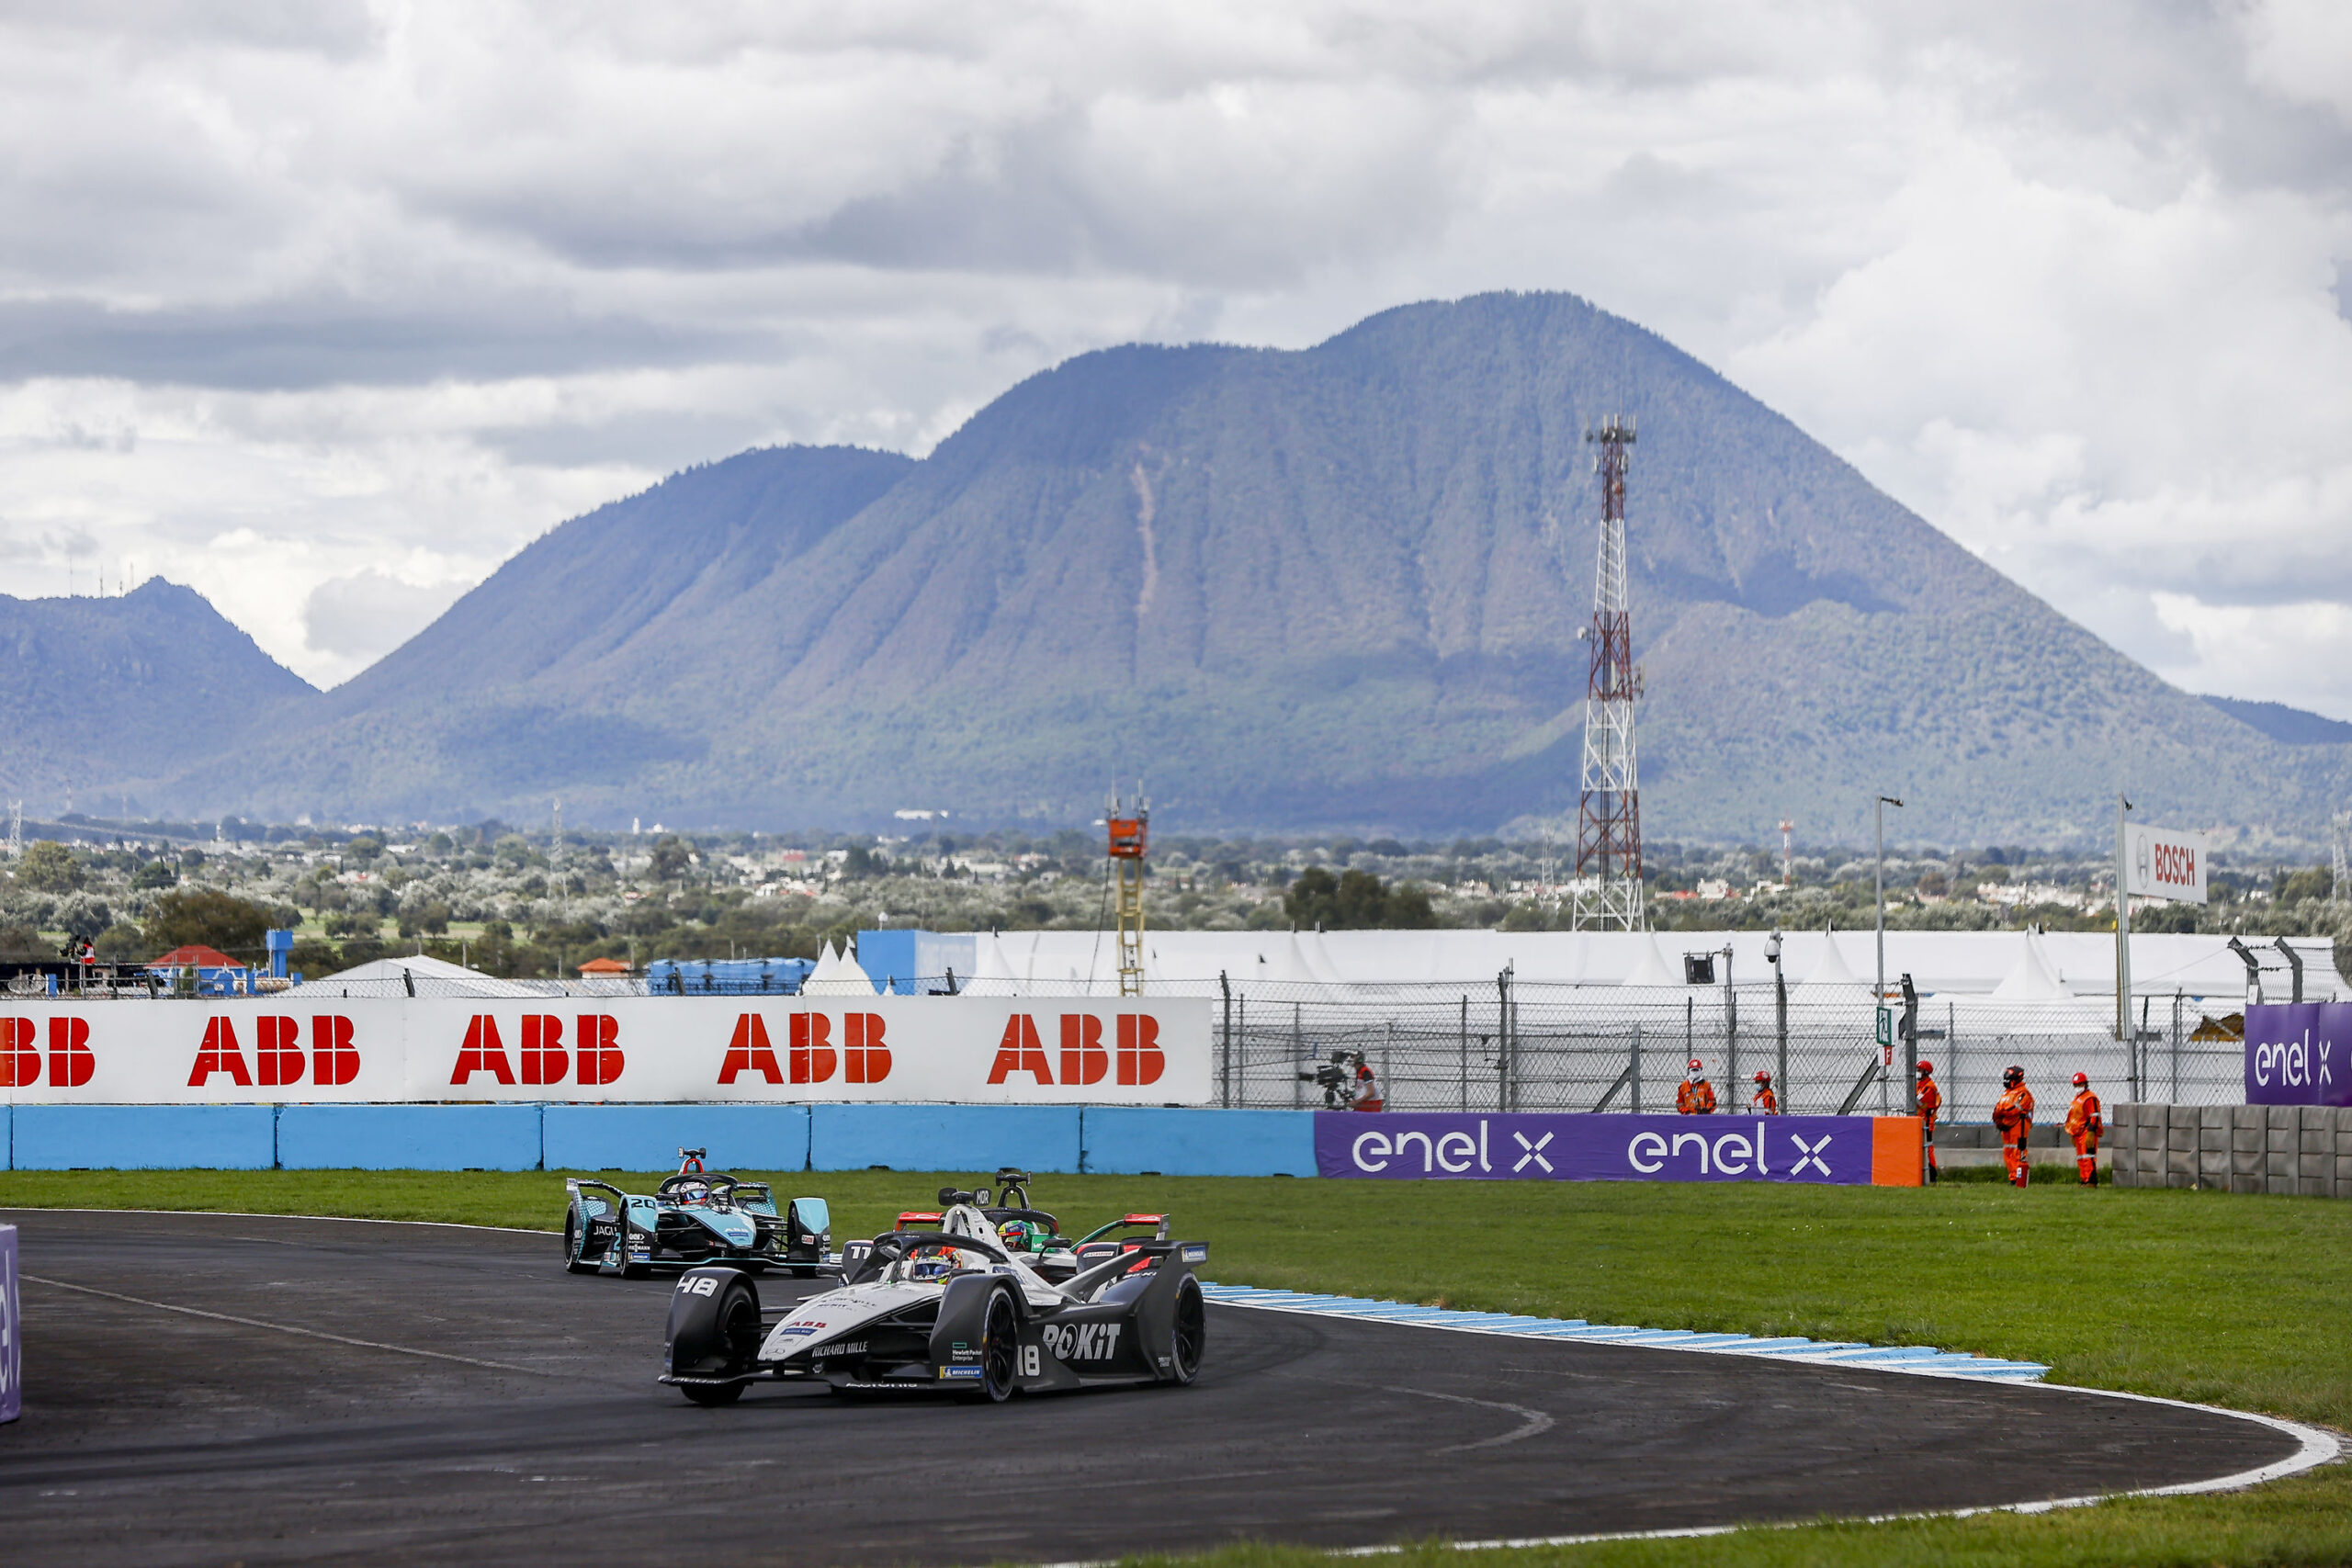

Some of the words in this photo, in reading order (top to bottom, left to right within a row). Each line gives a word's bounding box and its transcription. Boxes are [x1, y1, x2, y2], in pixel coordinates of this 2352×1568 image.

[2155, 842, 2195, 886] BOSCH
[0, 1017, 96, 1088] BB
[187, 1015, 361, 1087] ABB
[450, 1013, 625, 1086] ABB
[717, 1012, 893, 1085] ABB
[986, 1013, 1166, 1086] ABB
[2255, 1028, 2312, 1088] enel
[1351, 1119, 1493, 1173] enel
[1511, 1130, 1555, 1174] x
[1628, 1121, 1770, 1176] enel
[1789, 1133, 1833, 1178] x
[630, 1198, 656, 1210] 20
[593, 1225, 618, 1236] JAGU
[613, 1232, 622, 1251] 2
[850, 1246, 872, 1260] 11
[676, 1275, 718, 1298] 48
[786, 1320, 827, 1329] ABB
[811, 1344, 846, 1358] RICHARD
[846, 1340, 869, 1354] MILLE
